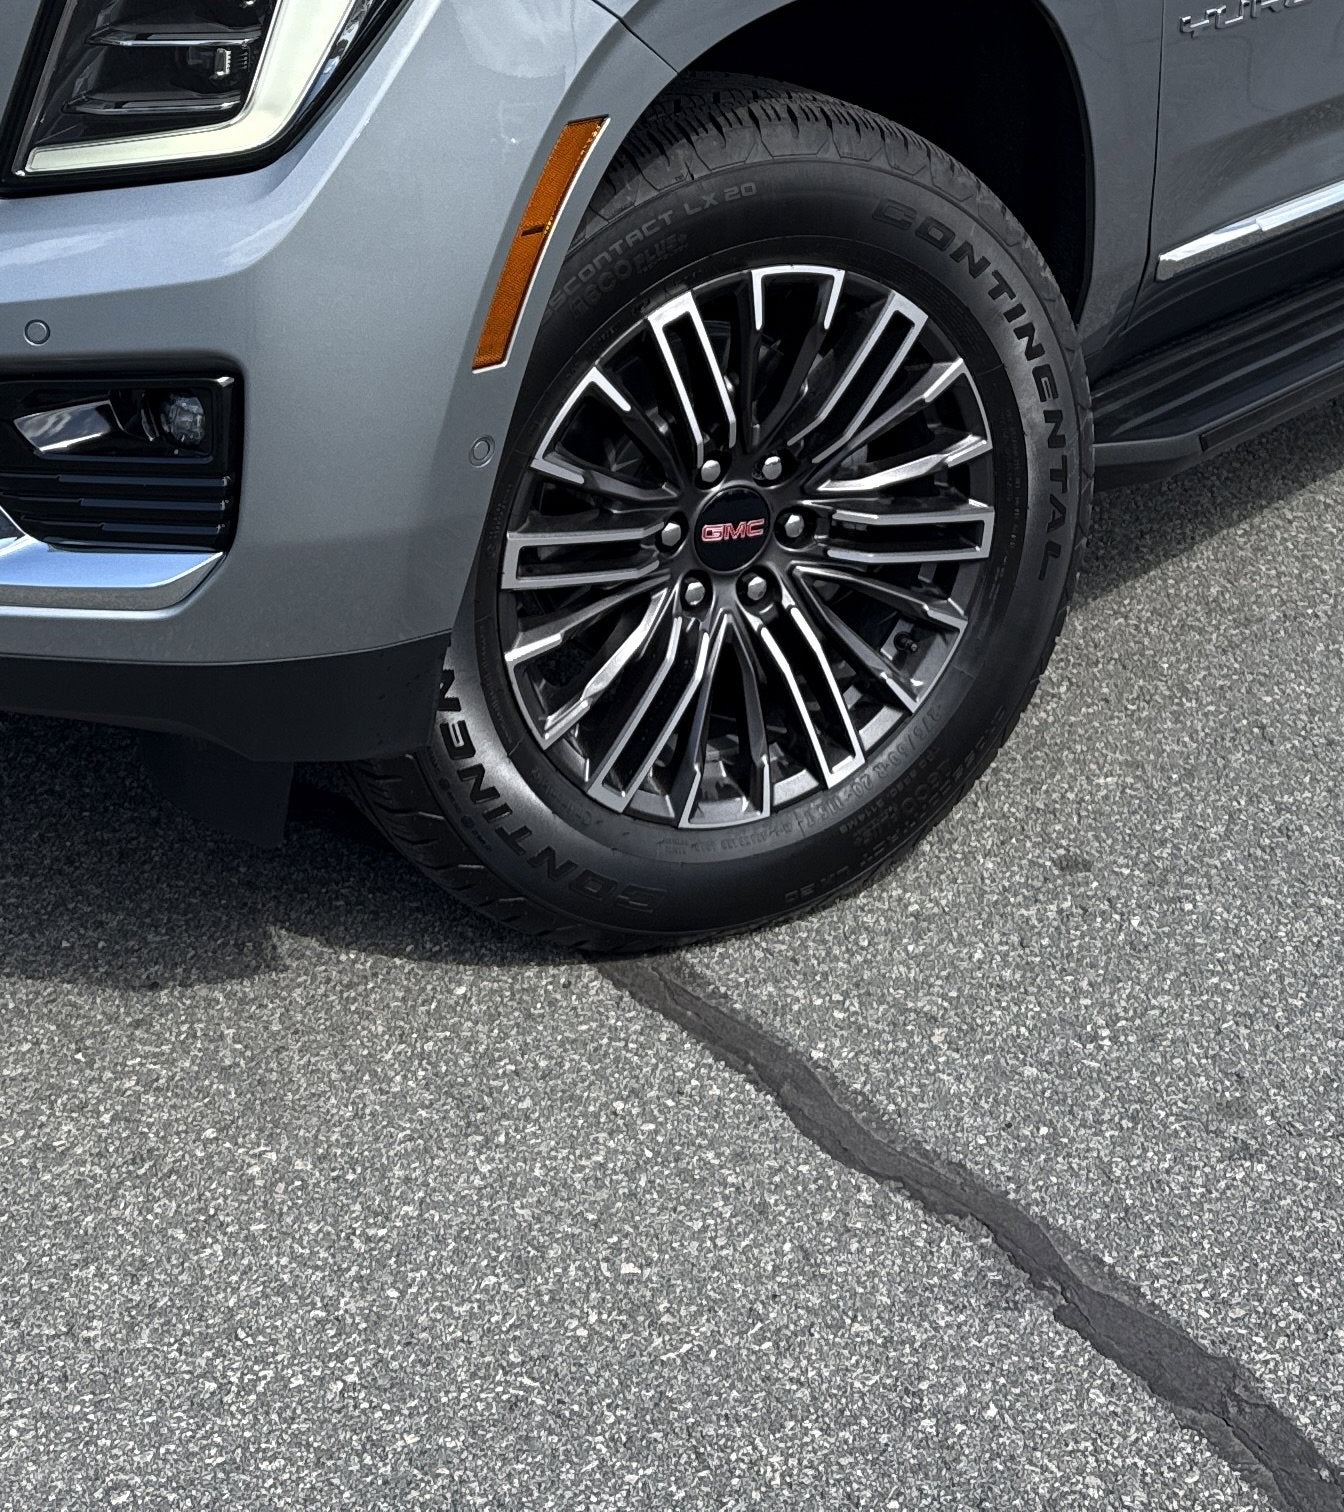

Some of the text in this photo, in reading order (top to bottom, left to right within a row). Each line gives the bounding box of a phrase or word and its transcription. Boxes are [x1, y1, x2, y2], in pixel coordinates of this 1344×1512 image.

[683, 191, 719, 216] LX
[723, 181, 757, 203] 20
[871, 198, 1068, 581] CONTINENTAL
[701, 517, 766, 543] GMC
[438, 669, 666, 914] CONTINEN
